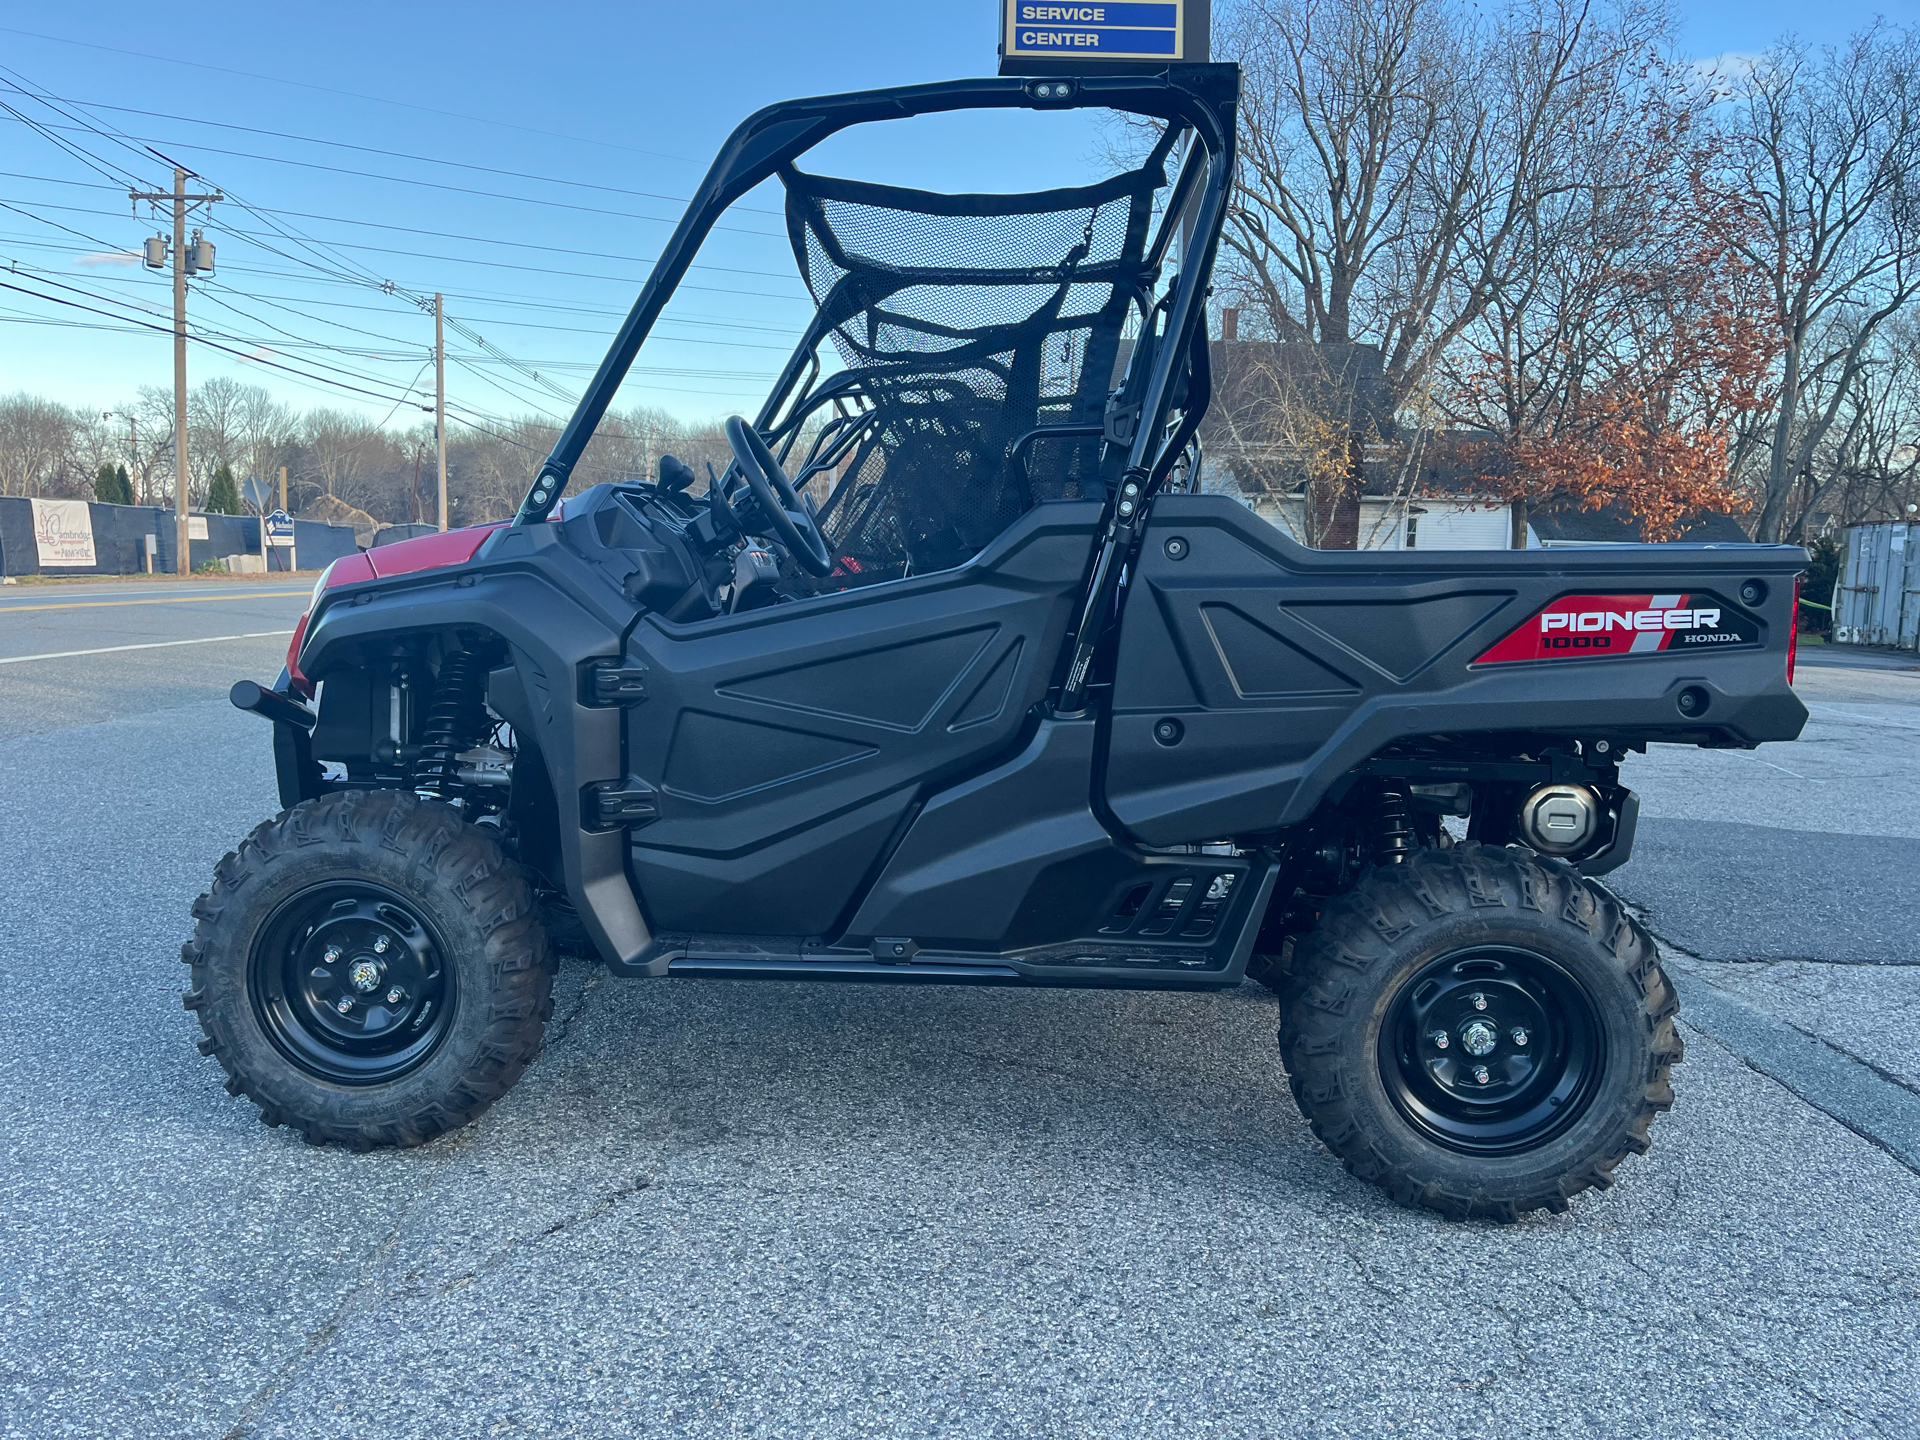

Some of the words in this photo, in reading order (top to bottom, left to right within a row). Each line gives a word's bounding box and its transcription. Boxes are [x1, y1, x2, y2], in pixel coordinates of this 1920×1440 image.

[1022, 6, 1105, 21] SERVICE
[1022, 31, 1099, 46] CENTER
[1541, 608, 1721, 632] PIONEER
[1541, 635, 1612, 649] 1000
[1684, 633, 1742, 643] HONDA
